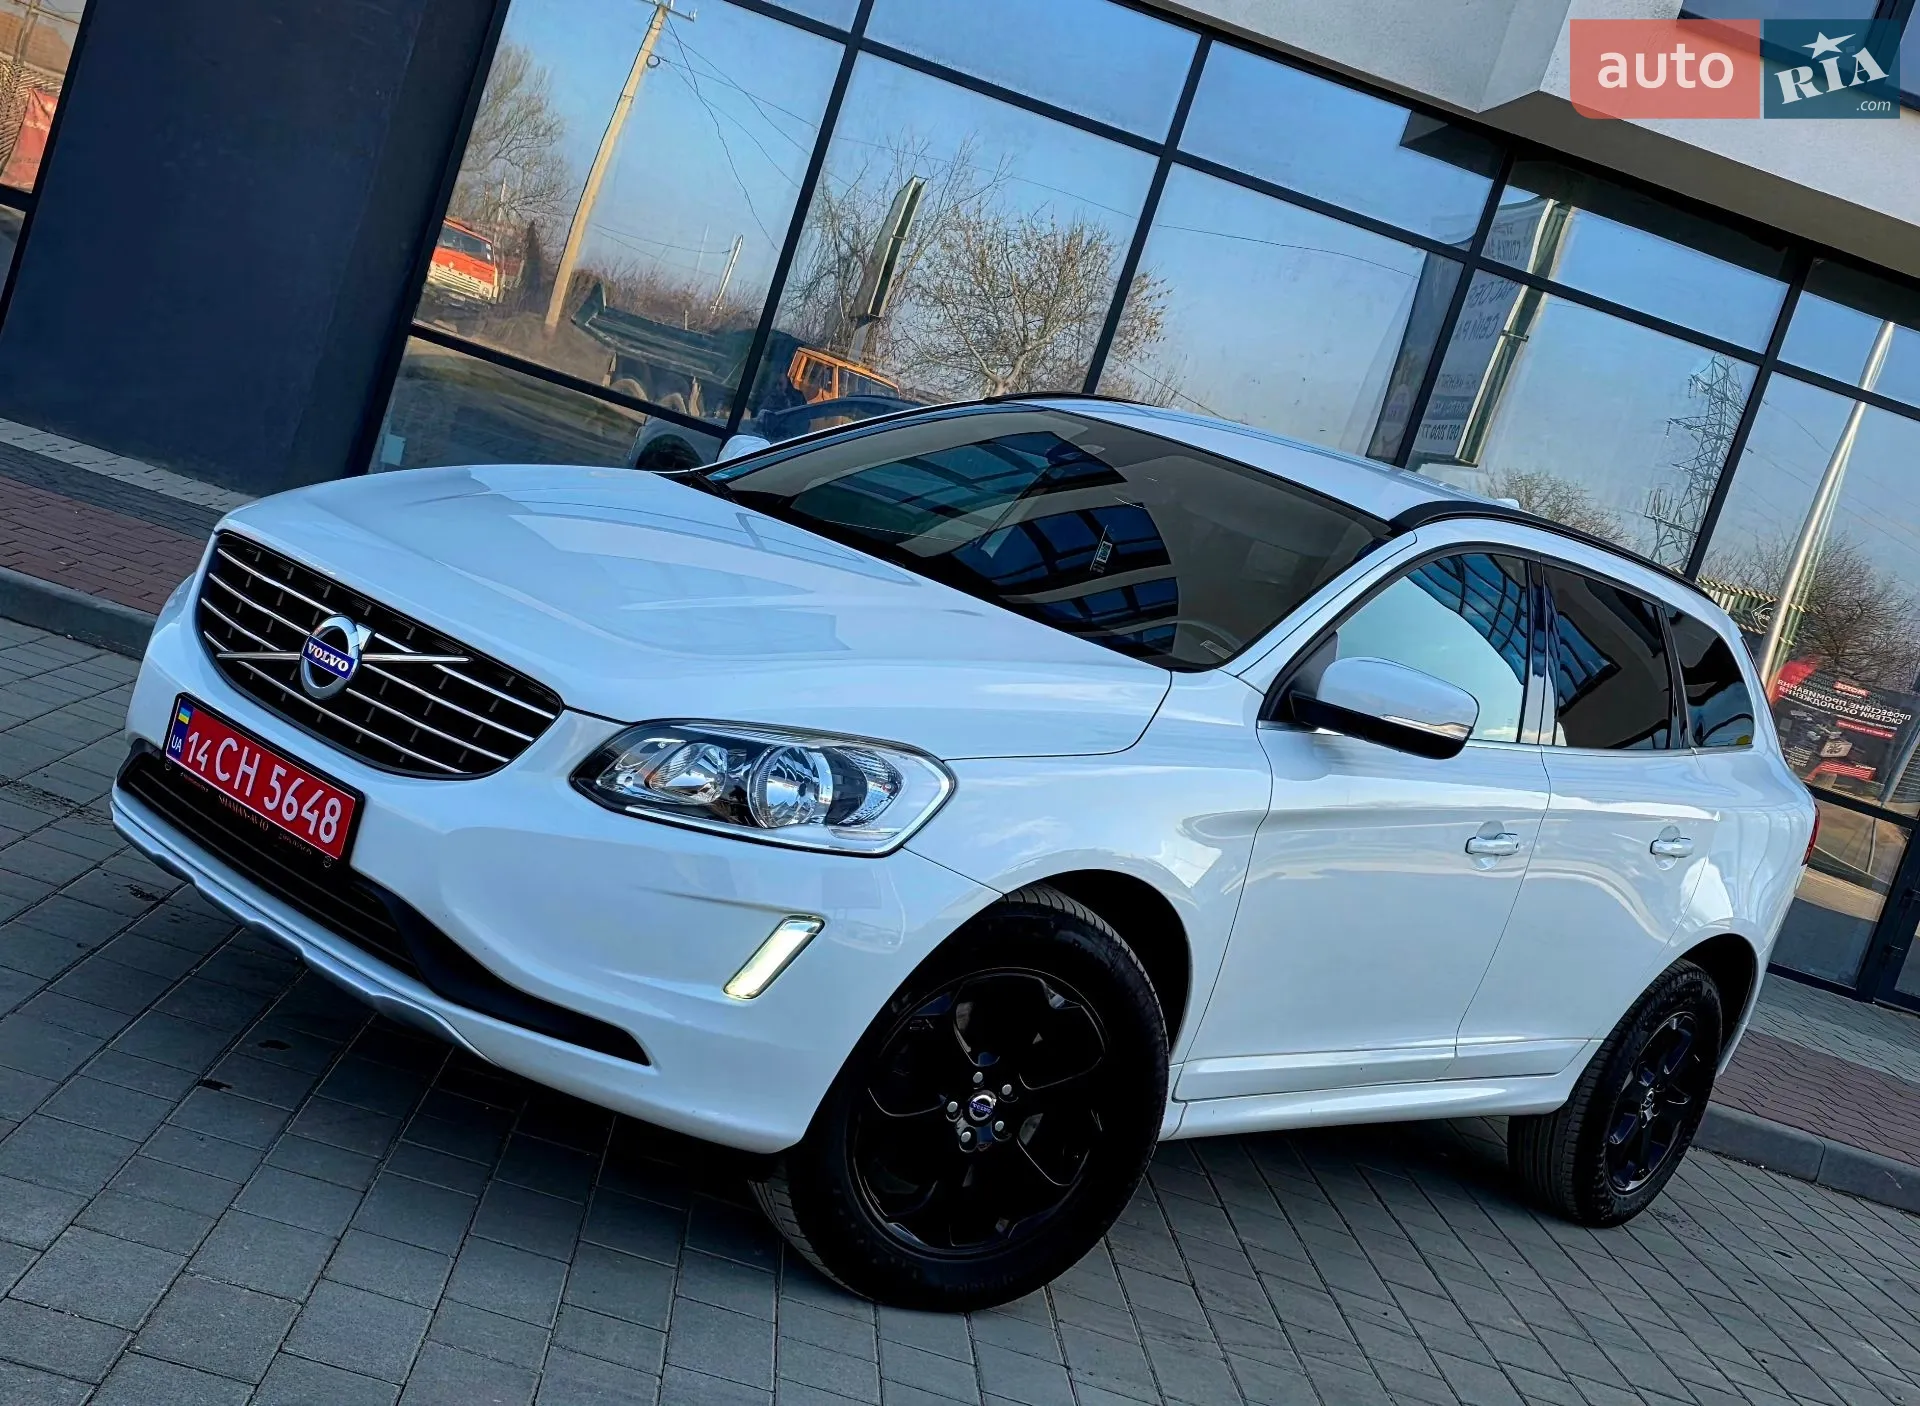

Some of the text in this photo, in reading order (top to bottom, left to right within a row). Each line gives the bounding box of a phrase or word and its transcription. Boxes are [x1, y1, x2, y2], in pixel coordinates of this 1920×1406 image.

[307, 641, 349, 672] VOLVO
[171, 734, 183, 753] UA
[187, 731, 342, 844] 14 CH 5648
